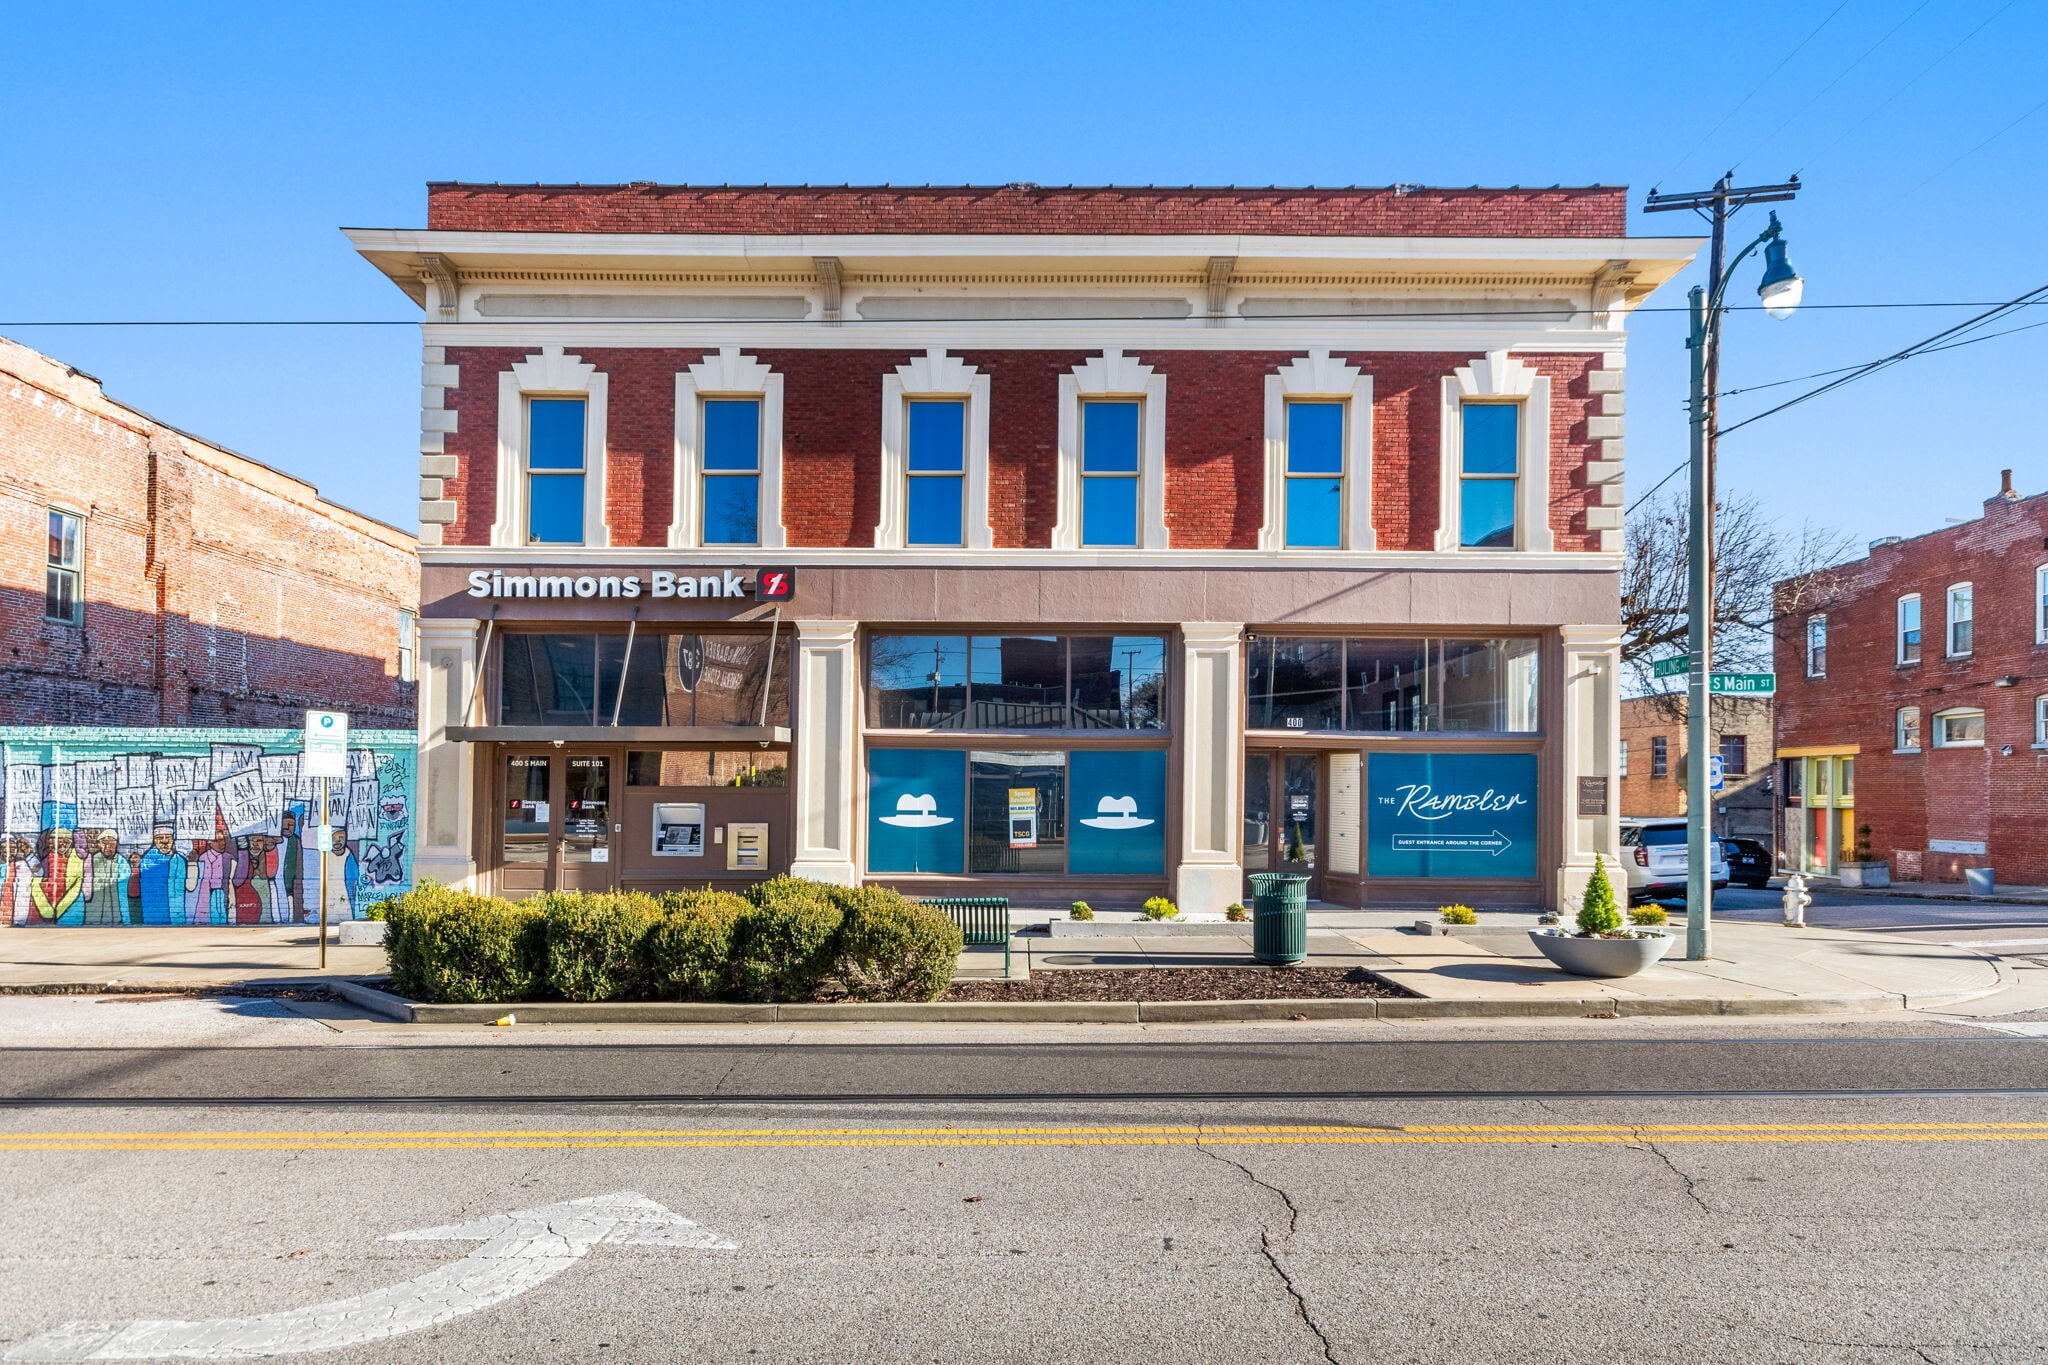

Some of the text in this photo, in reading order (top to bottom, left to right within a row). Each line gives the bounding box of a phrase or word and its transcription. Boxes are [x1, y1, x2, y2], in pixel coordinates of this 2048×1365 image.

[467, 569, 745, 598] Simmons Bank
[1655, 658, 1680, 677] HULING
[1713, 675, 1770, 690] S Main ST
[1287, 718, 1303, 727] 400
[232, 751, 253, 771] AM
[89, 766, 108, 790] AM
[166, 763, 187, 785] AM
[233, 777, 256, 801] AM
[357, 784, 374, 804] AM
[1378, 797, 1395, 805] THE
[228, 812, 239, 828] A
[236, 801, 264, 823] MAN
[355, 807, 376, 831] MAN
